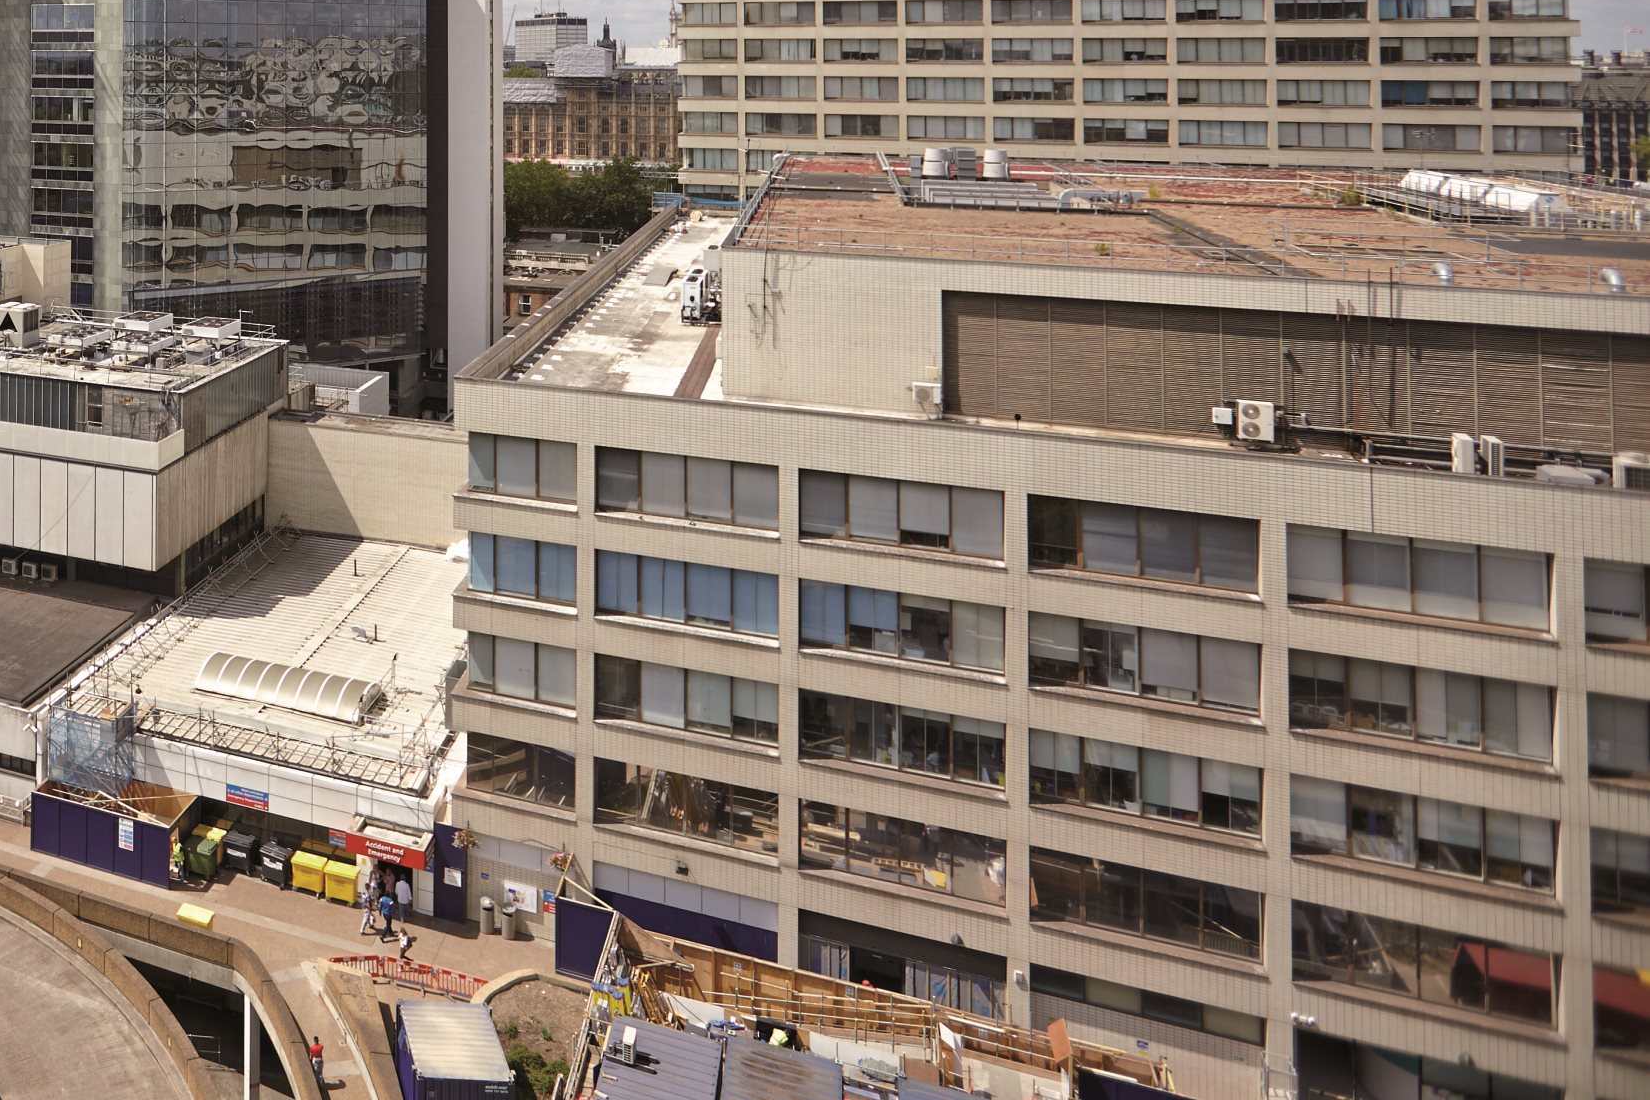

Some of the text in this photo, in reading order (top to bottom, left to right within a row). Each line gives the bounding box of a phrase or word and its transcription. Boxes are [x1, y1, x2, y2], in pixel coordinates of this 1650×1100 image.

[365, 840, 404, 856] Accident and
[368, 848, 401, 864] Emergency
